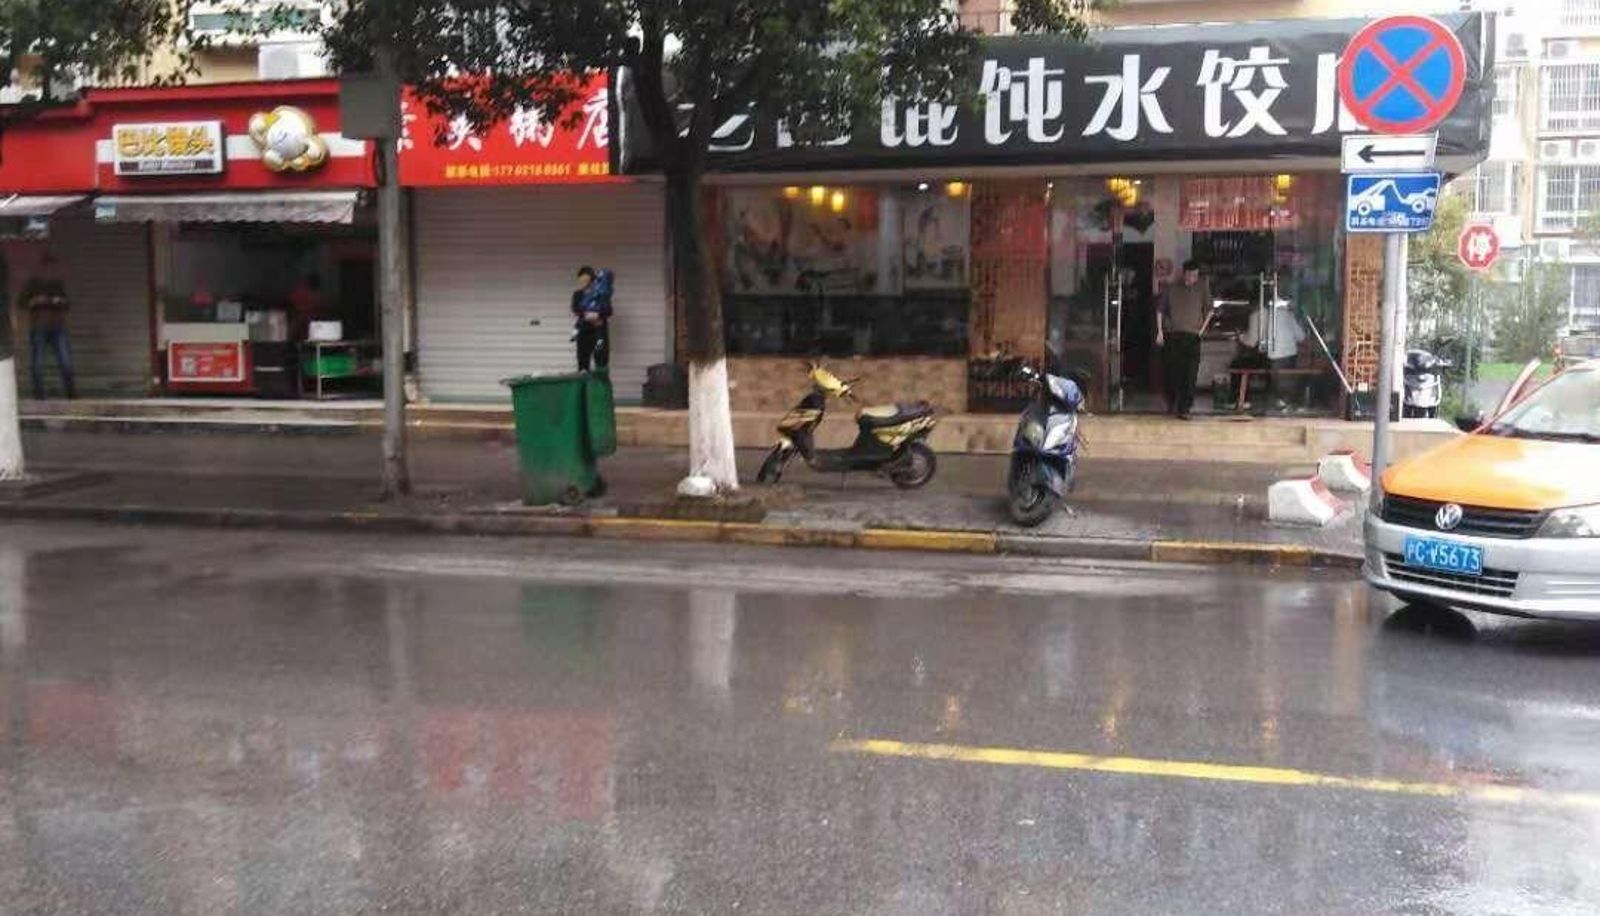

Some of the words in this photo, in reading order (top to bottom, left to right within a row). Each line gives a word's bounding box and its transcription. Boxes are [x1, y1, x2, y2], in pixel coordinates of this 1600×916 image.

[676, 46, 1368, 152] 馄饨水饺
[1467, 231, 1493, 262] 停
